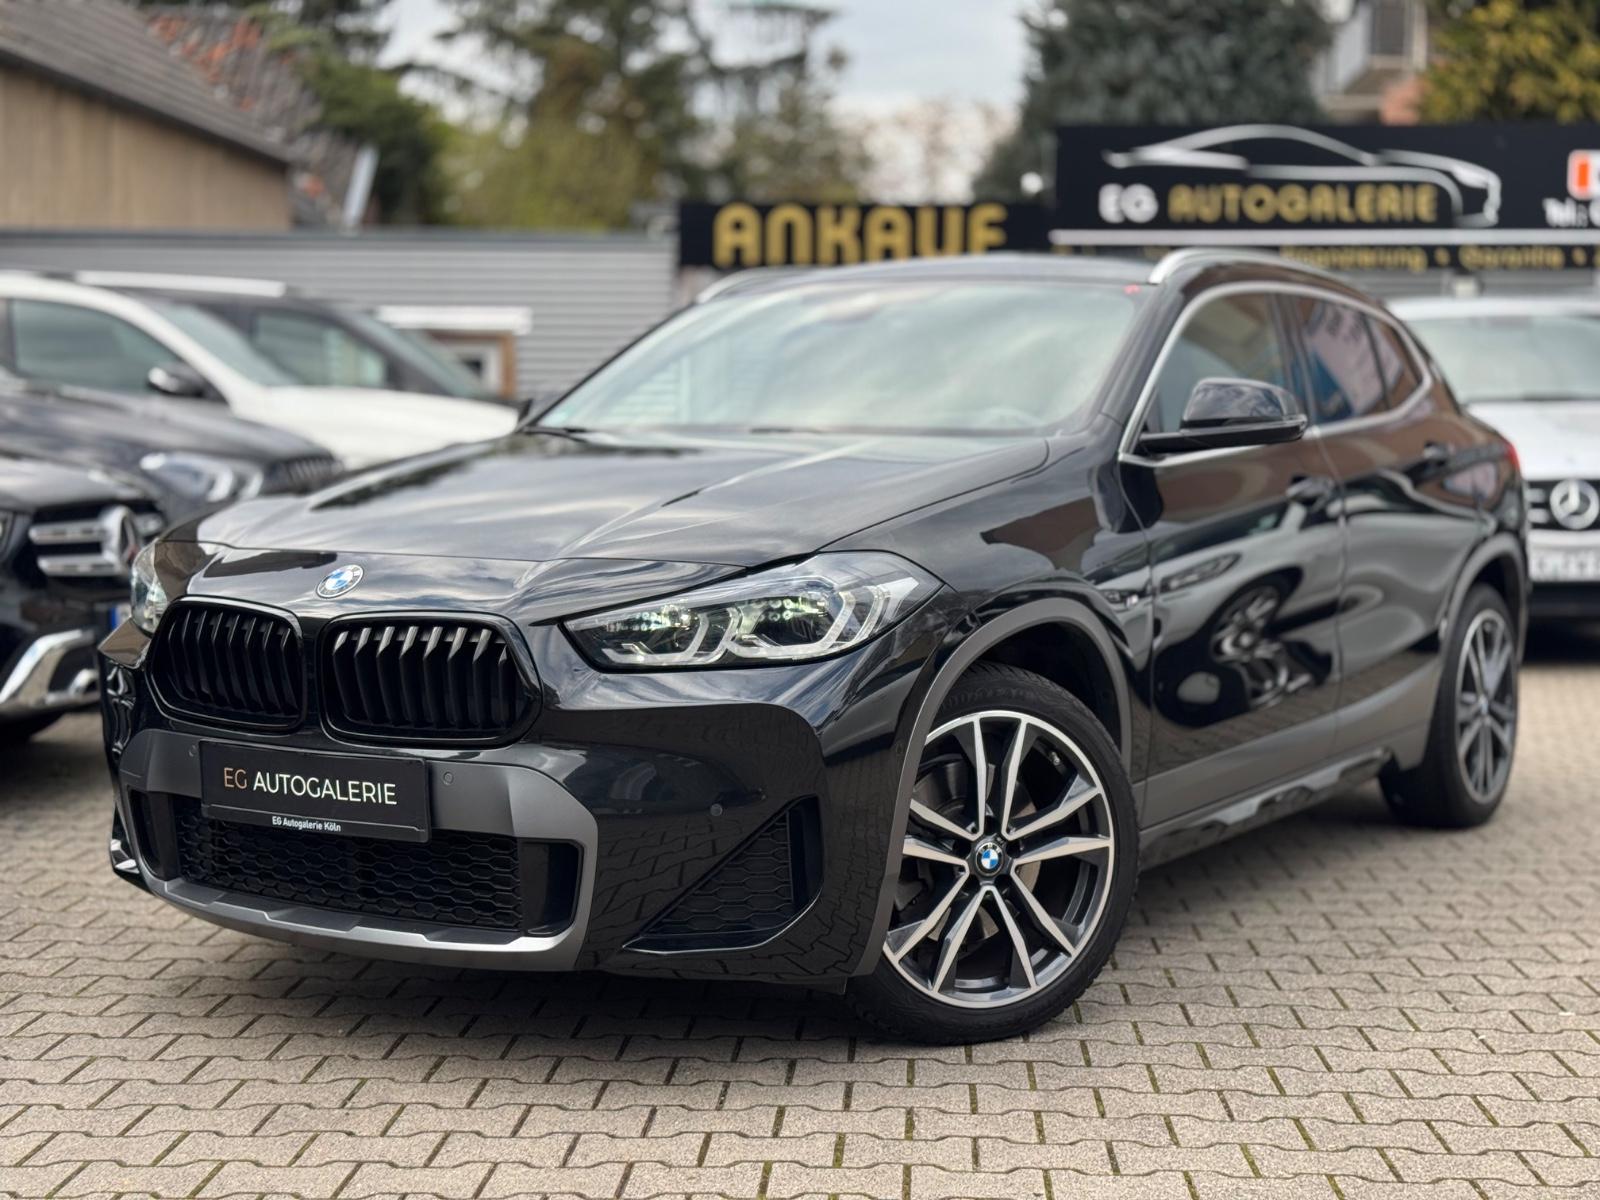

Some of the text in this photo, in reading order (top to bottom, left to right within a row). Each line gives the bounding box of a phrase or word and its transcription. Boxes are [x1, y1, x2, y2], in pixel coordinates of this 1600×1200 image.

[1099, 183, 1438, 223] EG AUTOGALERIE
[713, 202, 1008, 267] ANKAUF
[223, 767, 397, 805] EG AUTOGALERIE
[272, 816, 342, 832] EG Autogalerie Köln
